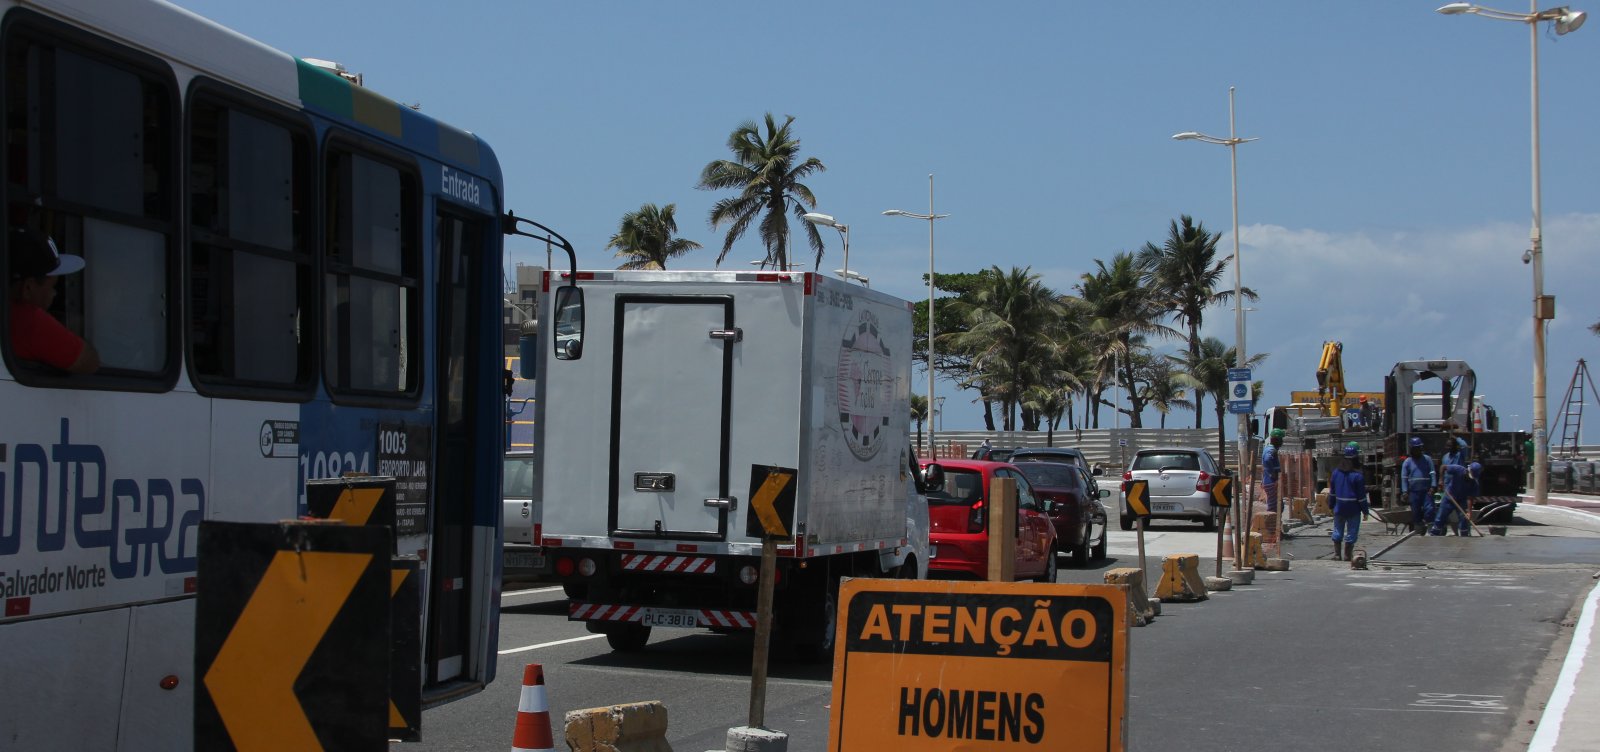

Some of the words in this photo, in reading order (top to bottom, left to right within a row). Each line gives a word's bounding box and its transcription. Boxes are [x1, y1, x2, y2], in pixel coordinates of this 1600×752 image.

[441, 165, 480, 206] Entrada
[379, 430, 407, 455] 1003
[0, 567, 63, 598] Salvador
[65, 563, 106, 591] Norte
[859, 599, 1097, 655] ATENÇÃO
[897, 686, 1045, 745] HOMENS
